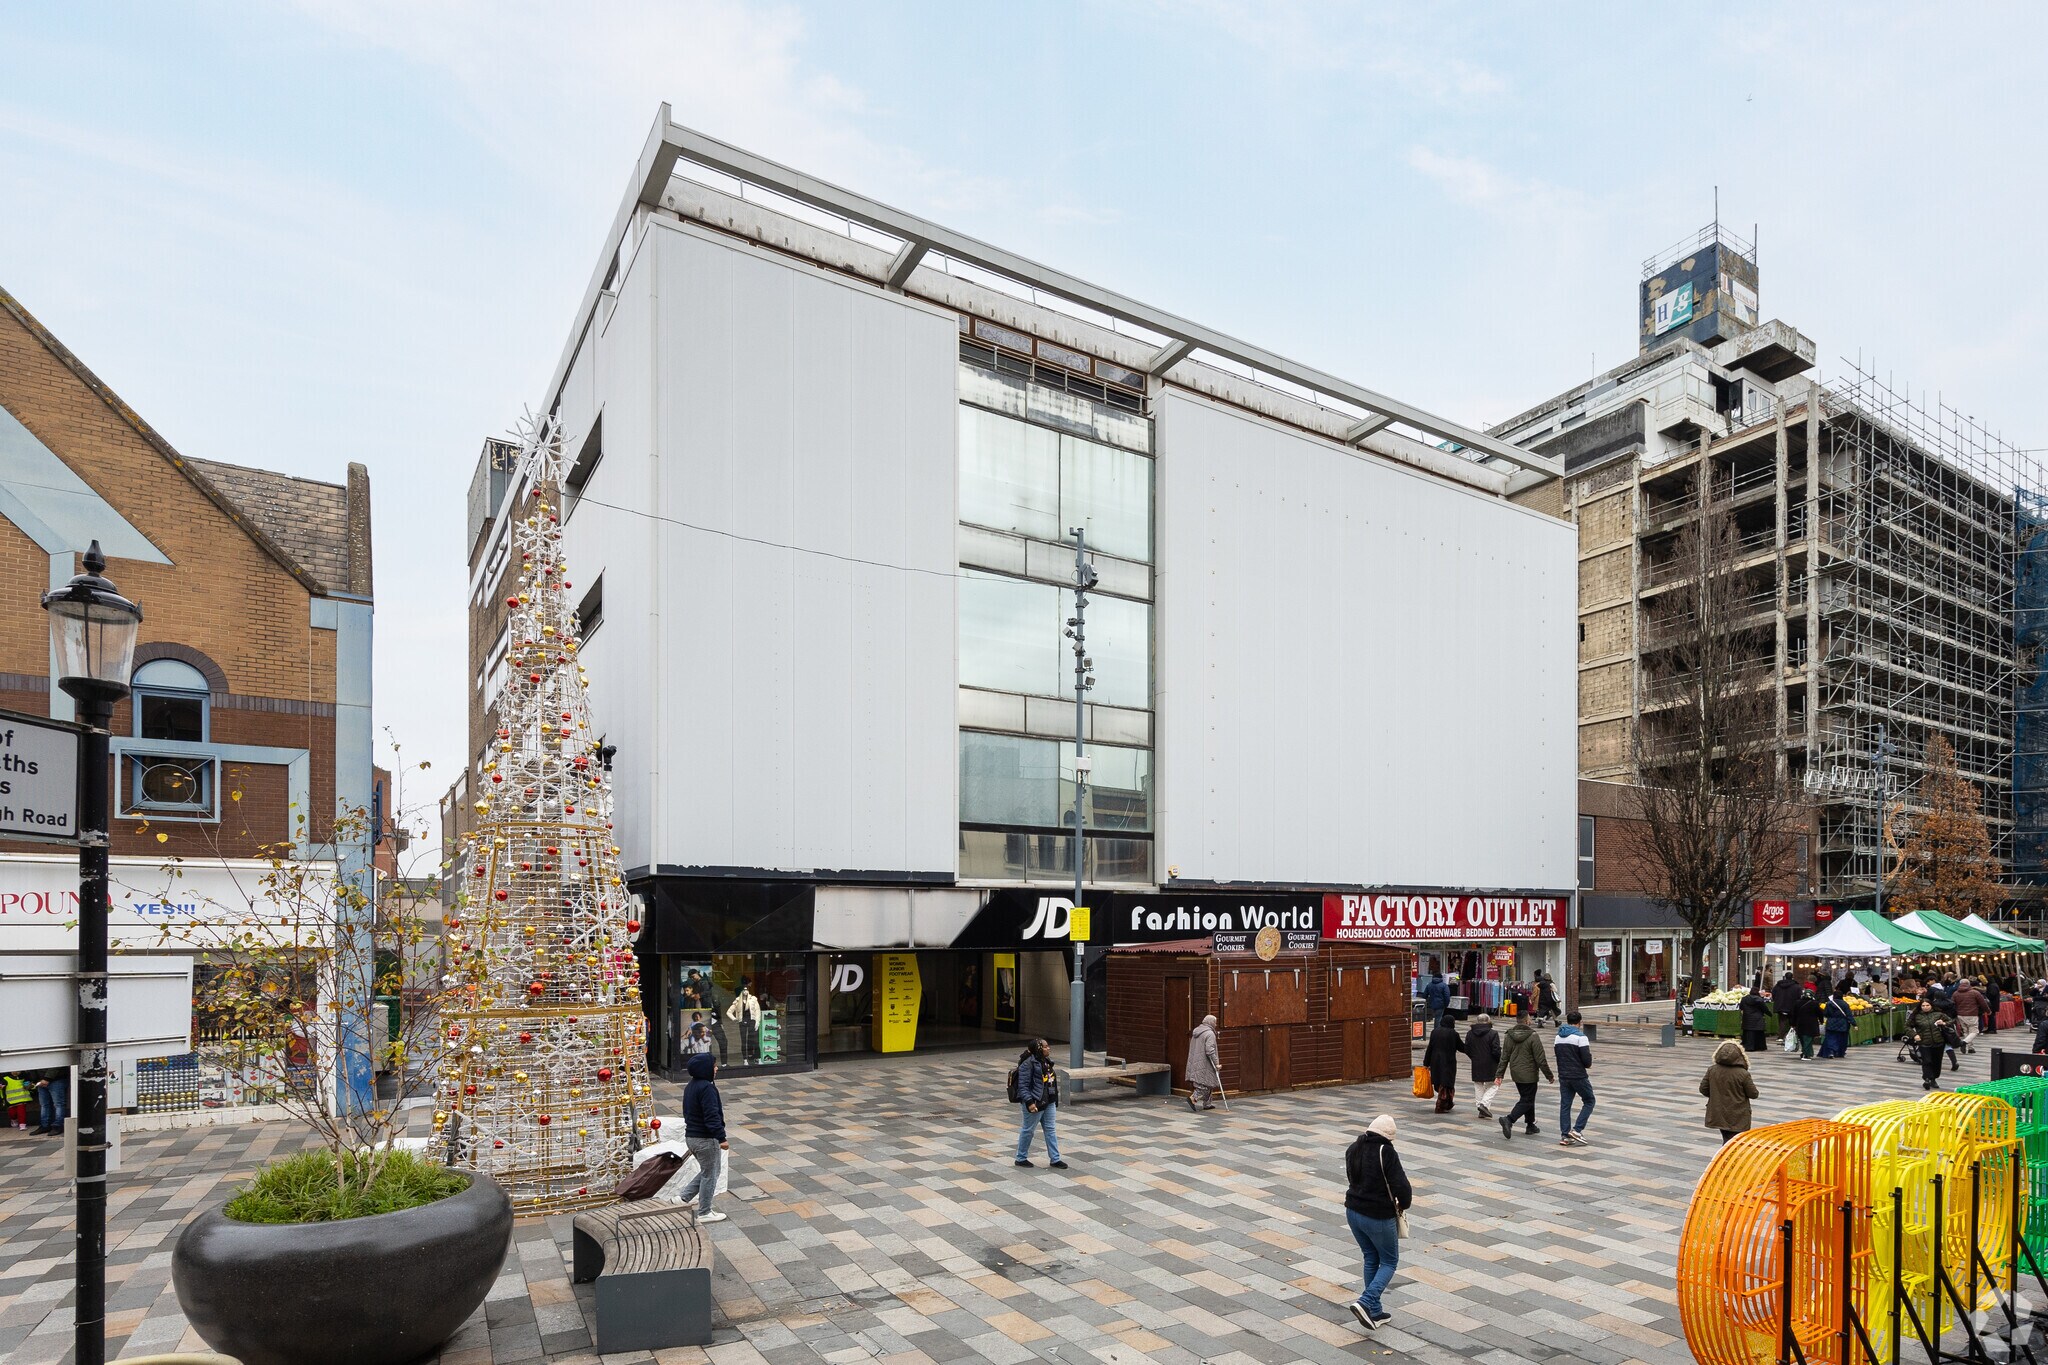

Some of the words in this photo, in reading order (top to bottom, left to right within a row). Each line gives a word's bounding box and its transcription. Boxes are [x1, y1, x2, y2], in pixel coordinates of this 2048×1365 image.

[0, 730, 14, 747] f
[0, 753, 39, 775] ths
[23, 808, 67, 826] Road
[0, 891, 112, 914] POUN
[134, 903, 196, 914] YES!!!
[1341, 895, 1459, 927] FACTORY
[1467, 897, 1556, 927] OUTLET
[1763, 903, 1784, 918] Argos
[1022, 897, 1075, 939] JD
[1131, 906, 1233, 930] Fashion
[1240, 906, 1314, 930] World
[1215, 934, 1247, 943] GOURMET
[1287, 932, 1316, 941] GOURMET
[1336, 928, 1382, 938] HOUSEHOLD
[1384, 928, 1410, 938] GOODS
[1415, 928, 1462, 938] KITCHENWARE
[1466, 928, 1494, 937] BEDDING
[1498, 928, 1536, 937] ELECTRONICS
[1540, 928, 1556, 937] RUGS
[1216, 943, 1245, 952] COOKIES
[1288, 941, 1315, 949] COOKIES
